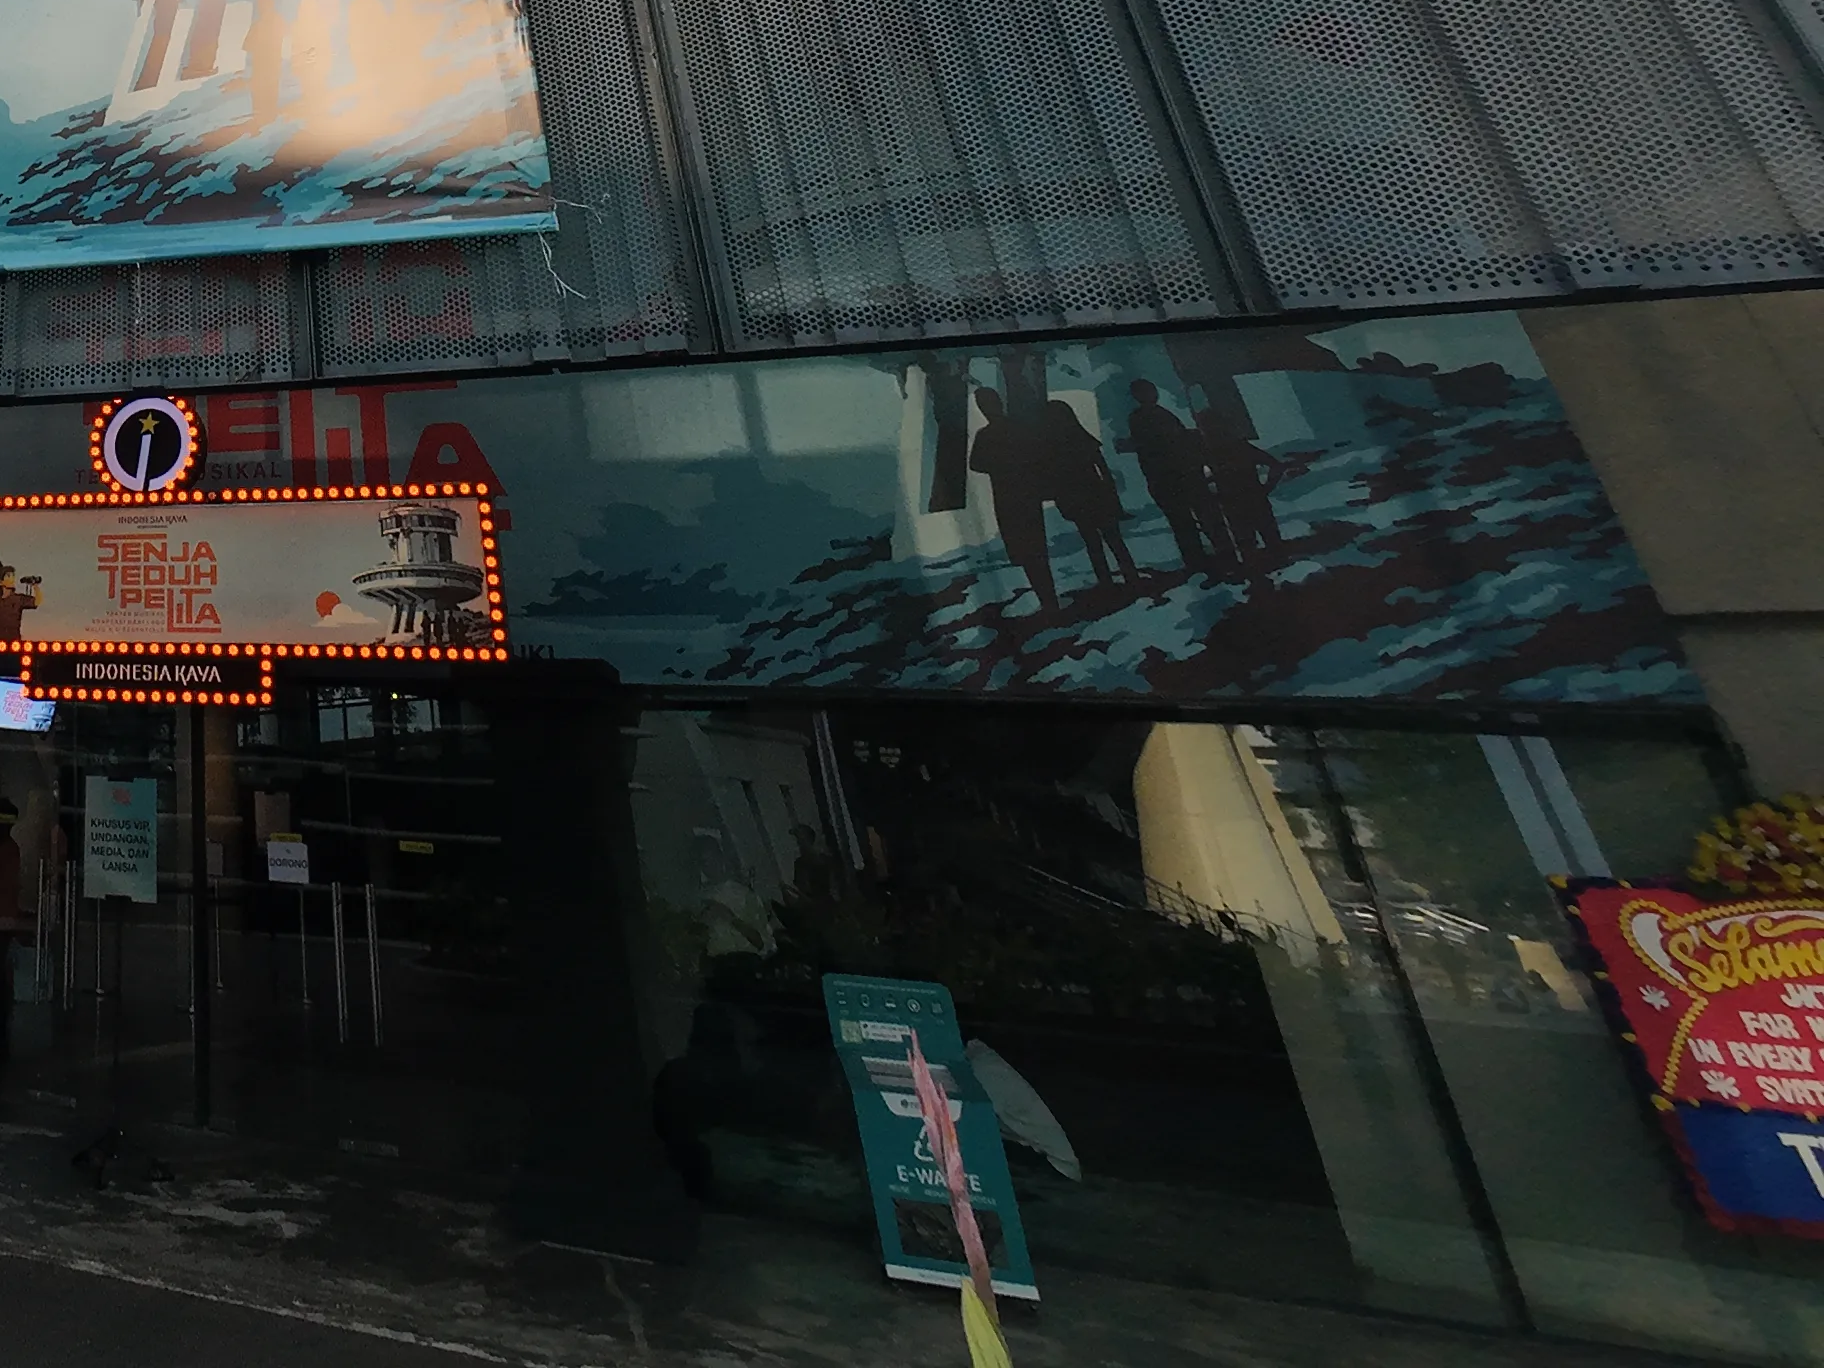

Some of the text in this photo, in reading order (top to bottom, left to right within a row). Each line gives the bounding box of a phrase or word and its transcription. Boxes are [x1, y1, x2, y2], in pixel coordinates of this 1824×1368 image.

[98, 533, 217, 563] SENJA
[98, 564, 217, 599] TEDUH
[120, 588, 222, 633] PELITA
[76, 663, 222, 686] INDONESIA KAYA
[90, 818, 131, 830] KHUSUS
[102, 860, 138, 872] LANSIA
[1668, 921, 1824, 994] Selam
[1738, 1011, 1801, 1040] FOR
[1688, 1039, 1726, 1065] IN
[1726, 1041, 1815, 1073] EVERY
[896, 1165, 982, 1193] E-WAE
